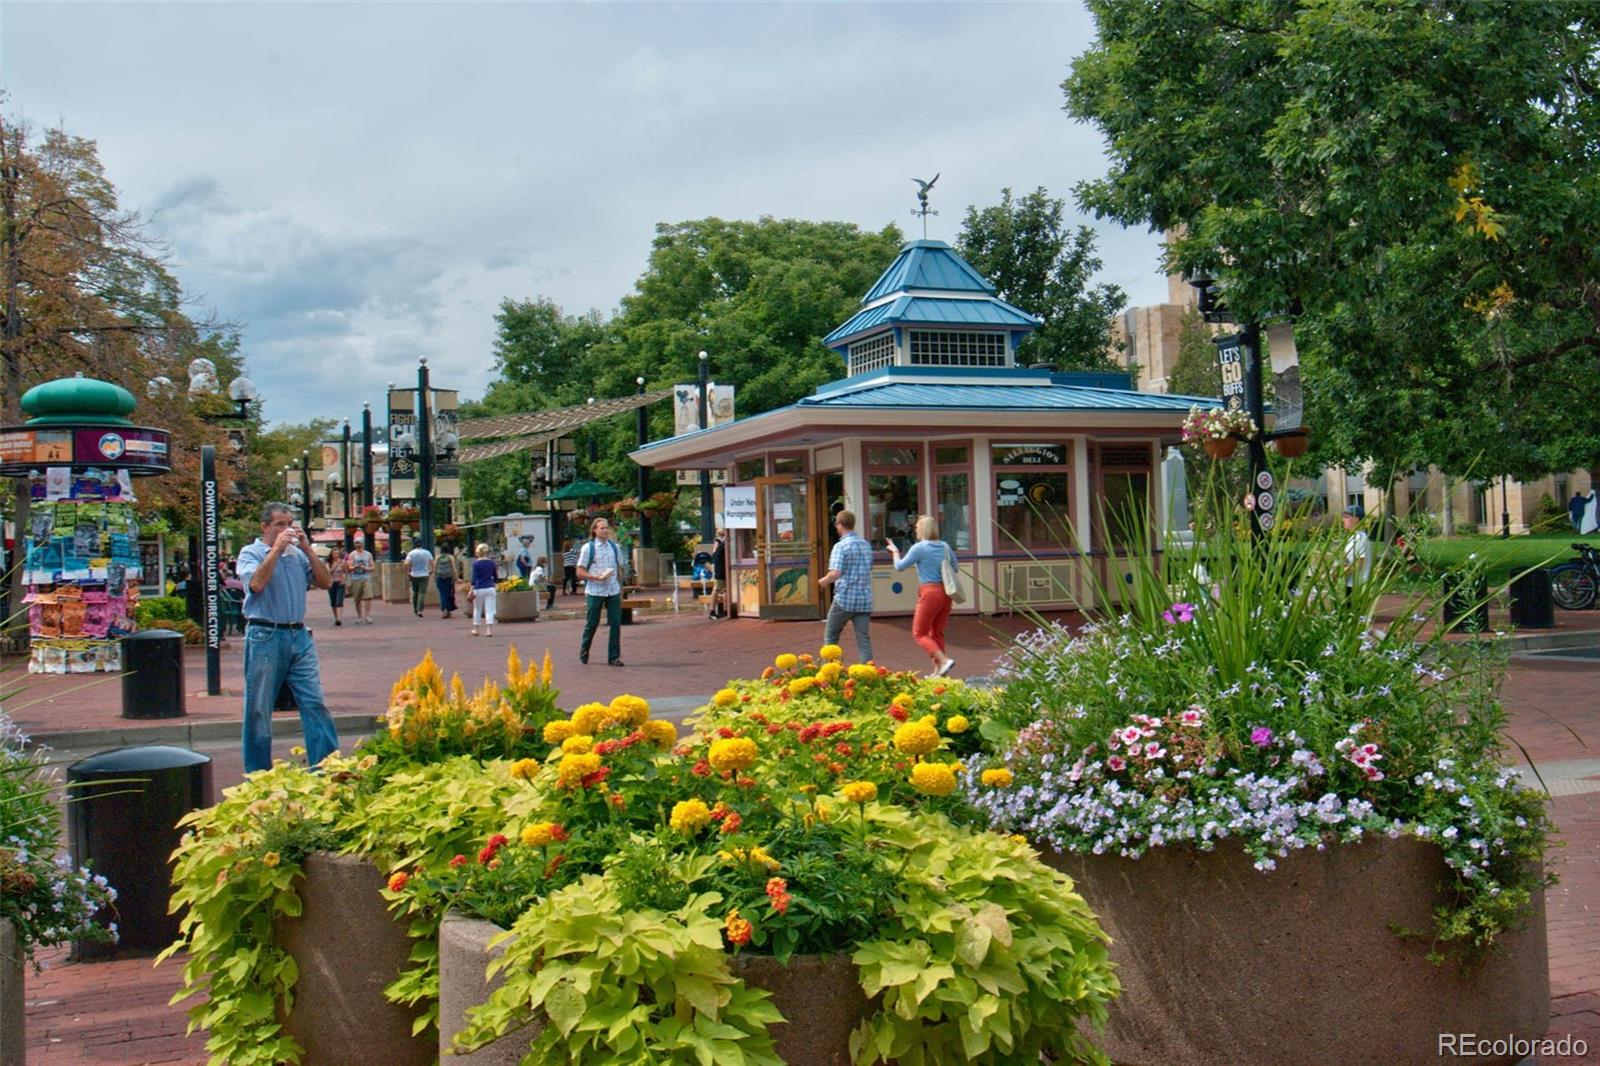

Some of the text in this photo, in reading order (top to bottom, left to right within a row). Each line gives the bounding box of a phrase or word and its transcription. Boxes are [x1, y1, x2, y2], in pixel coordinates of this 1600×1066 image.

[1219, 347, 1241, 364] LET'S
[1221, 362, 1242, 383] GO
[1223, 381, 1244, 396] BUFFS
[730, 498, 745, 506] Under
[727, 511, 757, 519] Managemen
[205, 480, 219, 649] DOWNTOWN BOULDER DIRECTORY
